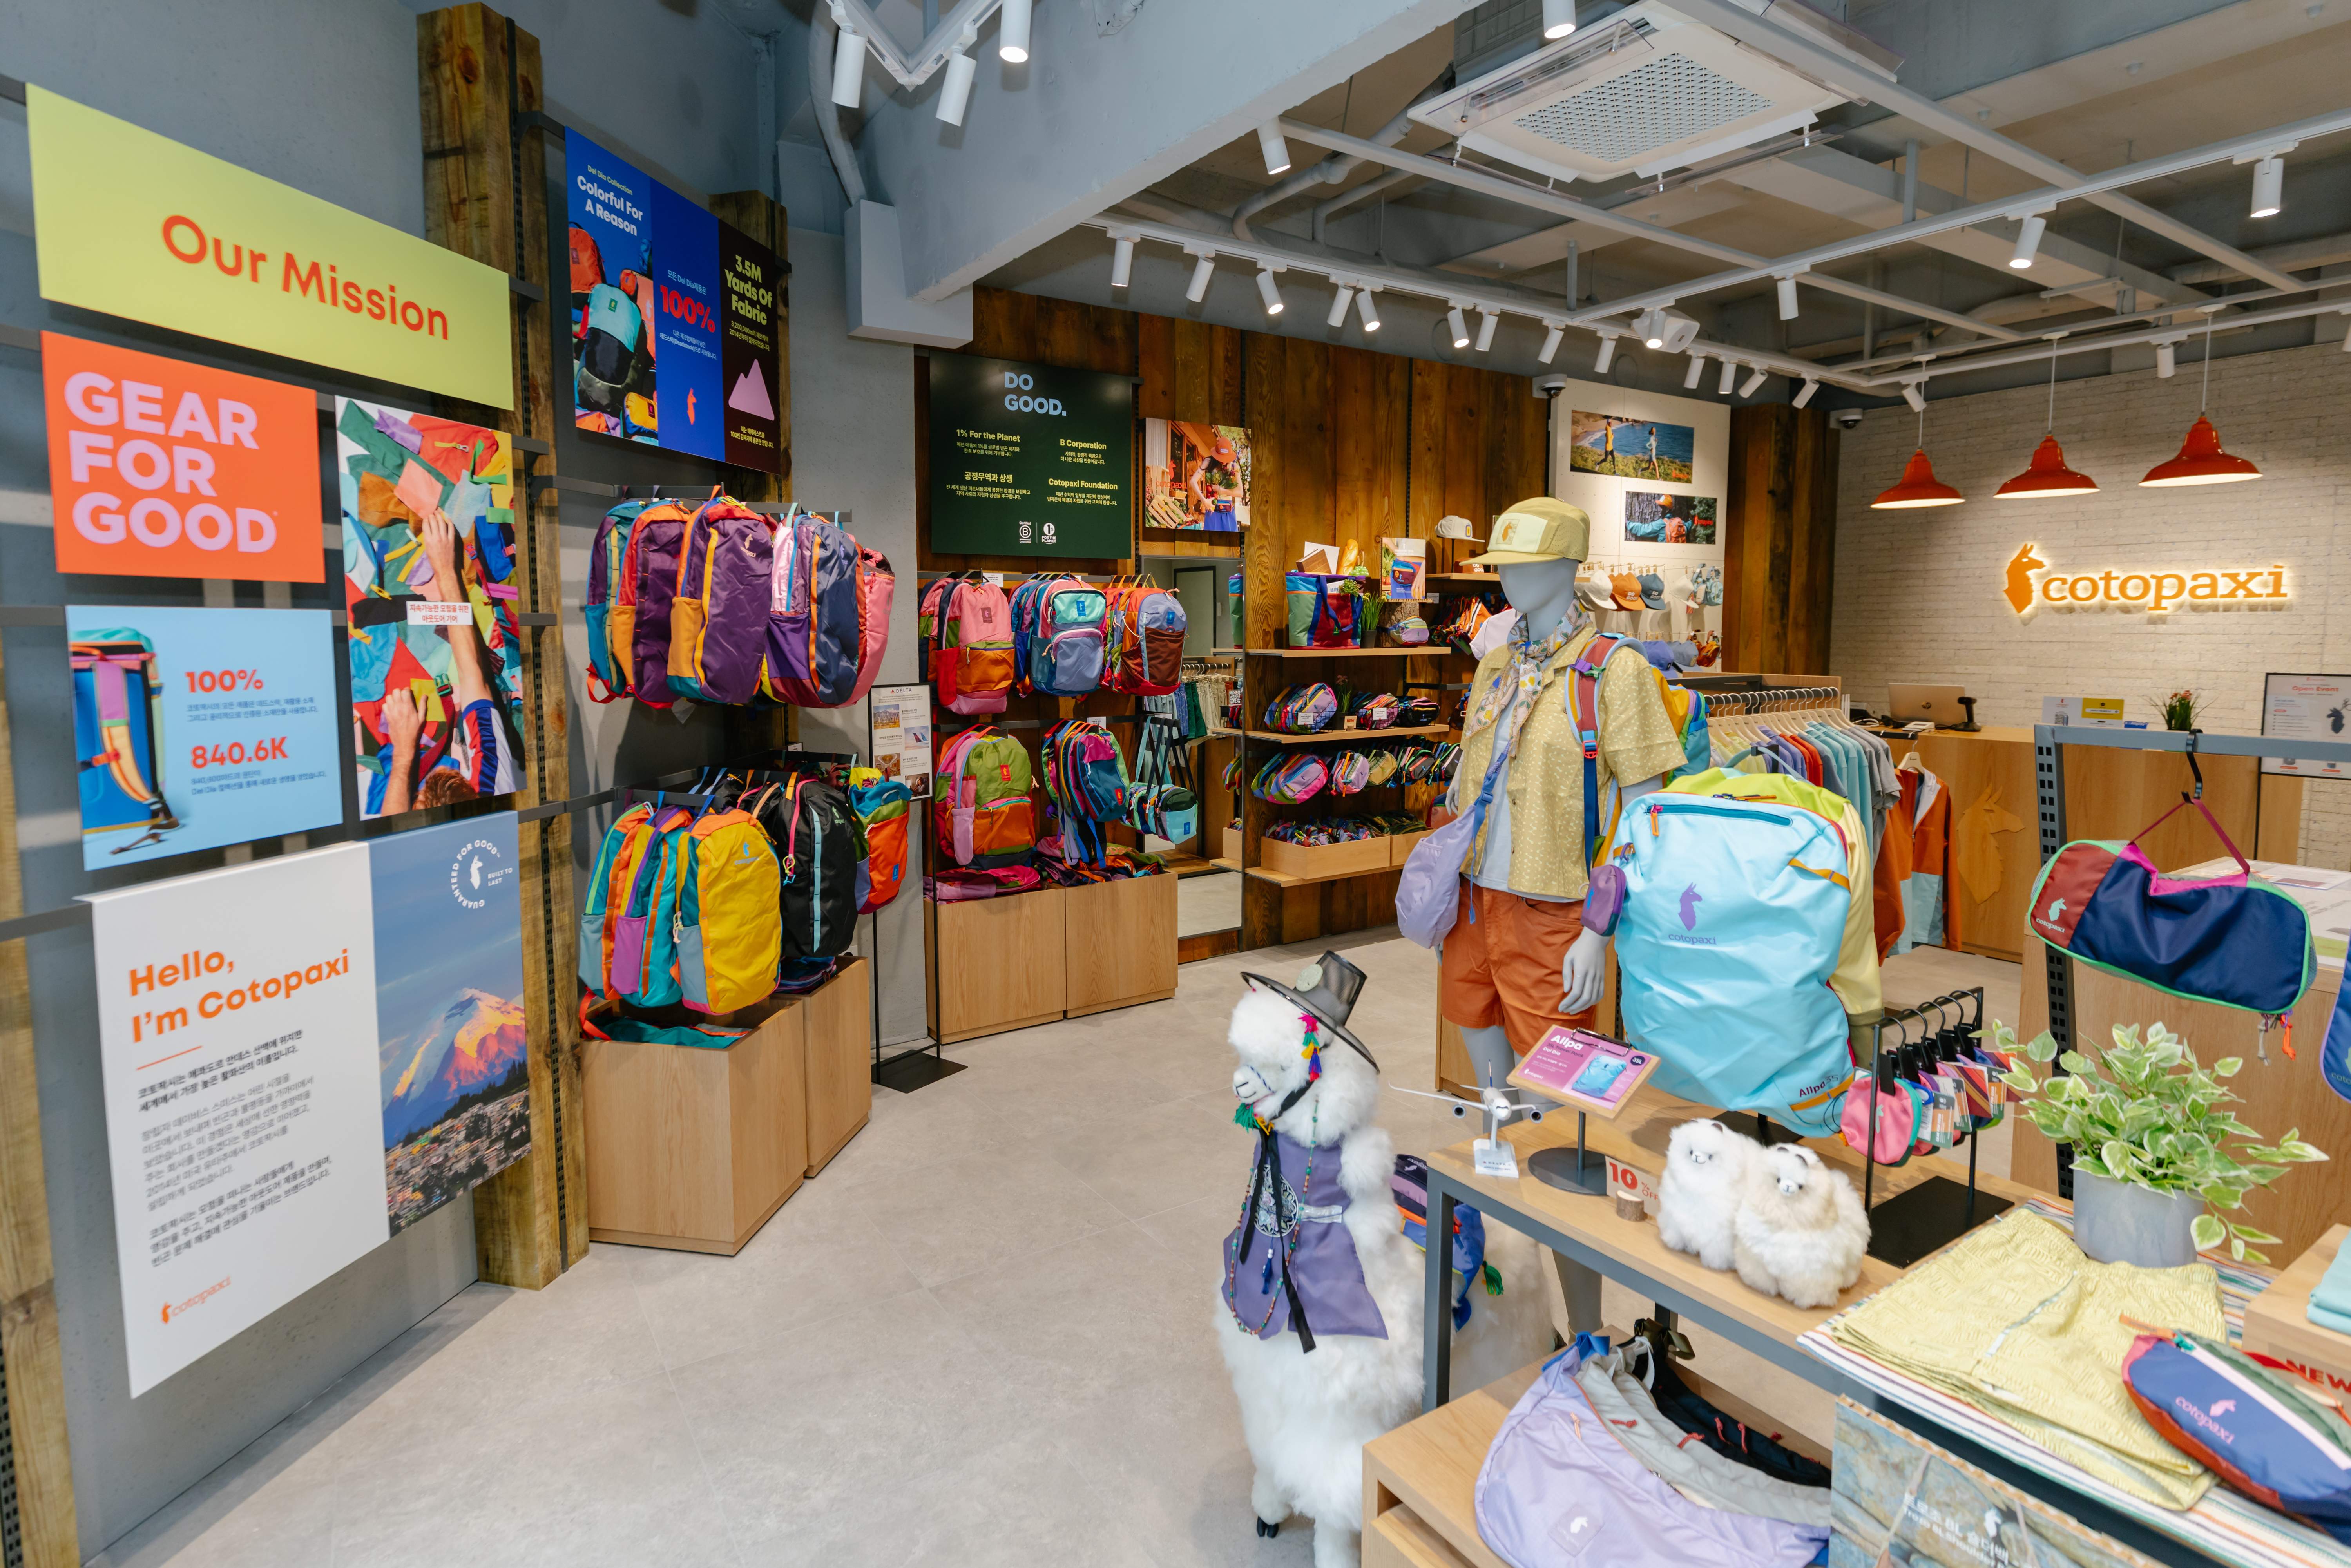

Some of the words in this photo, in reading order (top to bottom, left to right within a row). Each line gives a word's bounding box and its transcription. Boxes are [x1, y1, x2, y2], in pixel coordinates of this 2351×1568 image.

[607, 176, 632, 195] Collection
[577, 176, 624, 212] Colorful
[627, 201, 643, 221] For
[585, 199, 594, 214] A
[596, 205, 637, 237] Reason
[161, 214, 266, 284] Our
[281, 252, 449, 341] Mission
[668, 270, 677, 281] 모든
[677, 275, 686, 286] Del
[735, 254, 762, 284] 3.5M
[724, 269, 757, 301] Yards
[759, 288, 772, 308] Of
[660, 284, 715, 333] 100%
[731, 294, 767, 326] Fabric
[1005, 371, 1033, 391] DO
[64, 371, 260, 450] GEAR
[1005, 394, 1067, 416] GOOD.
[997, 433, 1020, 442] Planet
[1067, 440, 1107, 449] Corporation
[68, 429, 218, 497] FOR
[965, 472, 998, 482] 공정무역과
[1000, 474, 1012, 483] 상생
[1049, 478, 1079, 487] Cotopaxi
[1081, 480, 1118, 489] Foundation
[1022, 527, 1028, 536] B
[2042, 565, 2288, 611] cotopaxi
[185, 669, 264, 693] 100%
[191, 736, 289, 769] 840.6K
[456, 843, 473, 861] FOR
[451, 863, 485, 909] GUARANTEED
[488, 870, 504, 879] BUILT
[488, 878, 502, 886] LAST
[2035, 917, 2065, 933] cotopaxi
[1668, 932, 1717, 946] cotopaxi
[129, 949, 235, 997] Hello,
[131, 1006, 188, 1044] I'm
[198, 948, 350, 1020] Cotopaxi
[1550, 1035, 1583, 1050] Allpa
[1800, 1081, 1826, 1097] Allpa
[1826, 1075, 1838, 1084] 35
[1609, 1161, 1638, 1190] 10
[1641, 1182, 1650, 1191] %
[1641, 1188, 1659, 1201] OFF
[171, 1276, 231, 1316] cotopaxi
[2175, 1396, 2235, 1445] cotopaxi
